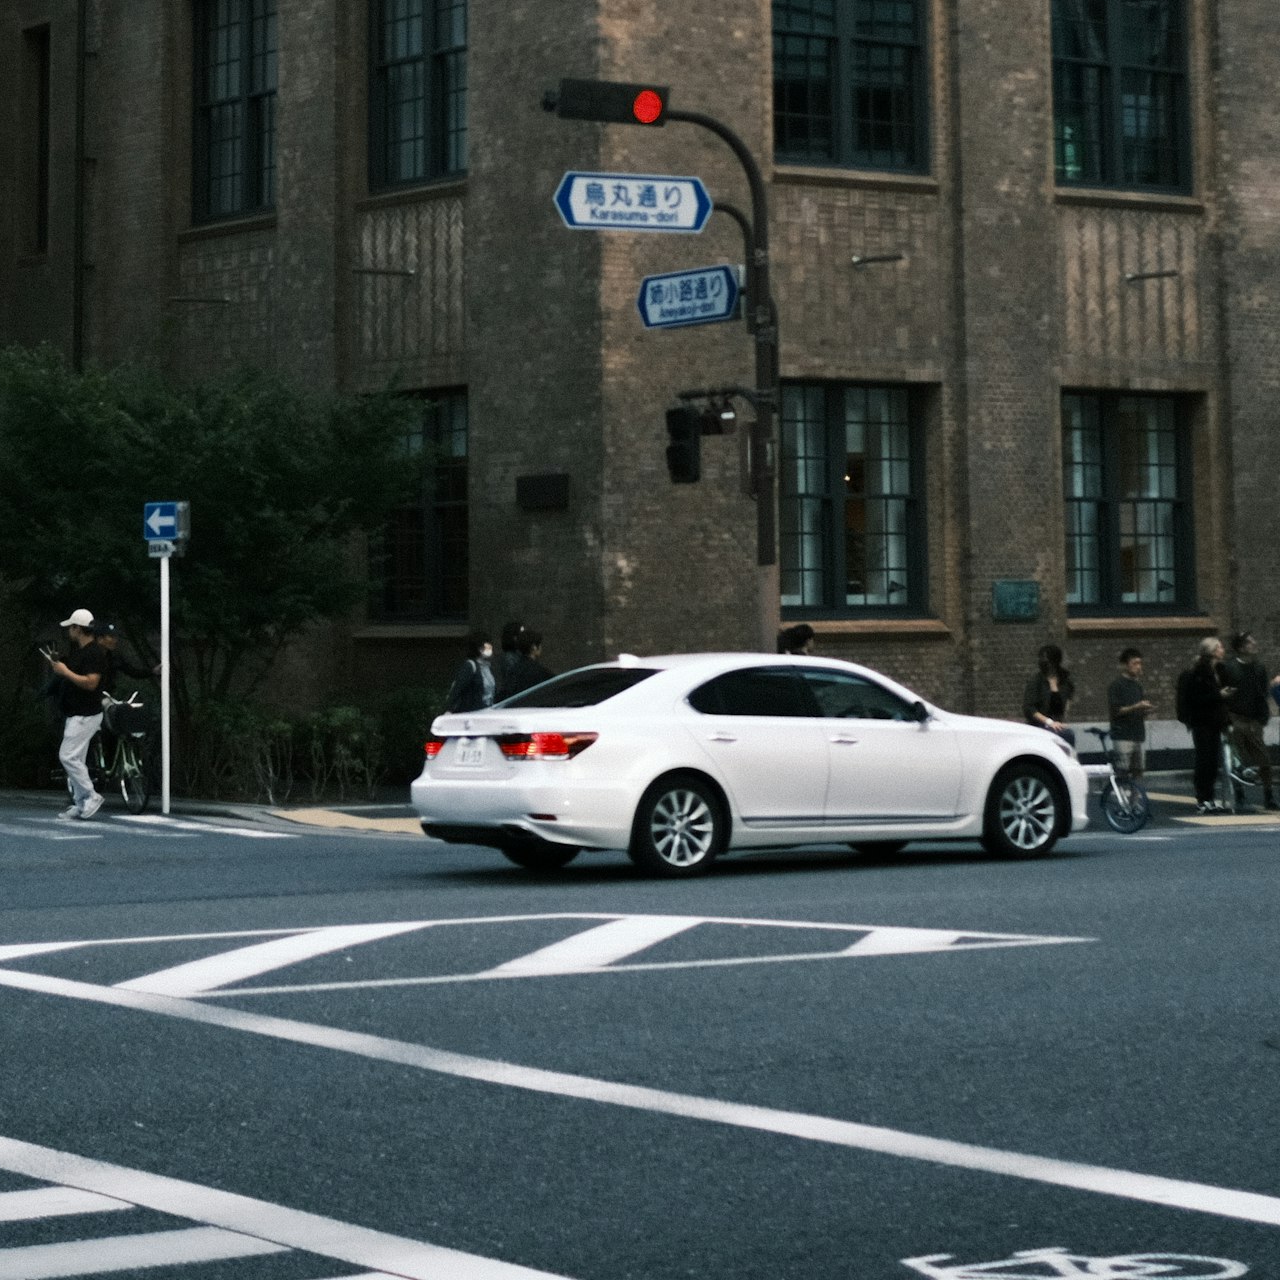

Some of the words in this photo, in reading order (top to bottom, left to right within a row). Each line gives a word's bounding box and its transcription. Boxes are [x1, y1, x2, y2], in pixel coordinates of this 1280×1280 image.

[585, 181, 682, 209] 烏丸通り
[590, 207, 679, 222] Karasuma-dori
[649, 274, 723, 306] 姉小路通り
